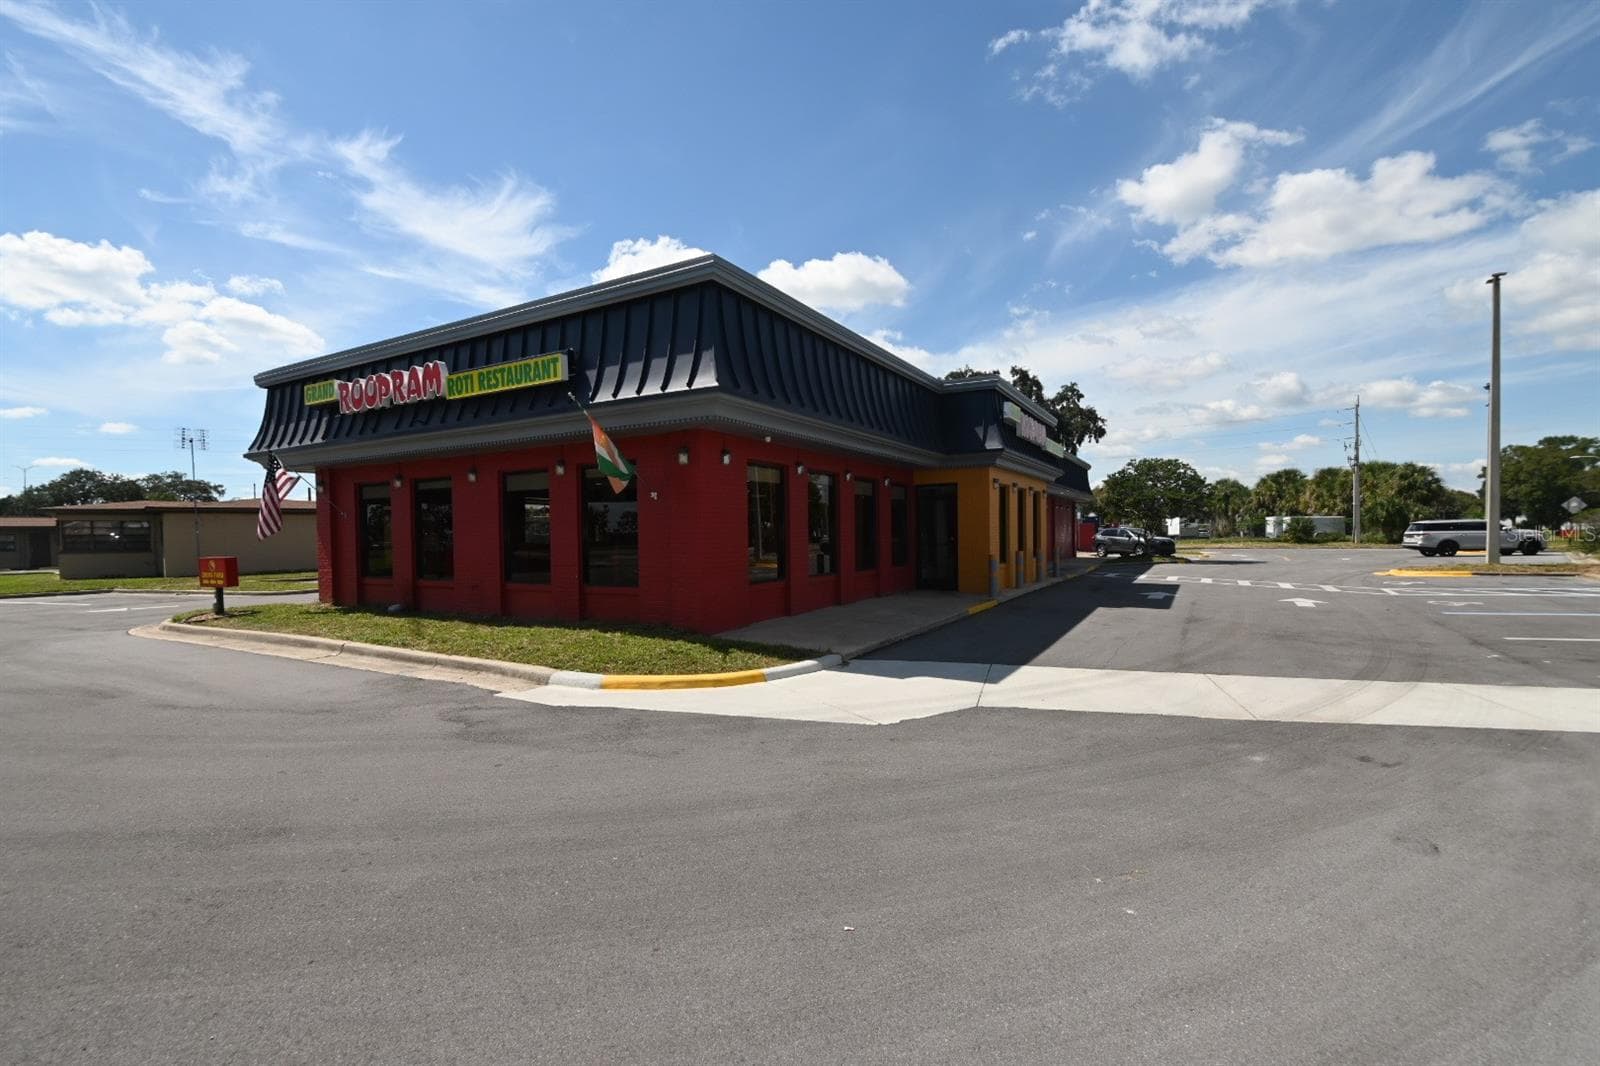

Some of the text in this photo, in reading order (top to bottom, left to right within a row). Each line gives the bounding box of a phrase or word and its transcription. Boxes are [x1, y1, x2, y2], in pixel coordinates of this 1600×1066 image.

[305, 357, 560, 414] GRAND ROOPRAM ROTI RESTAURANT
